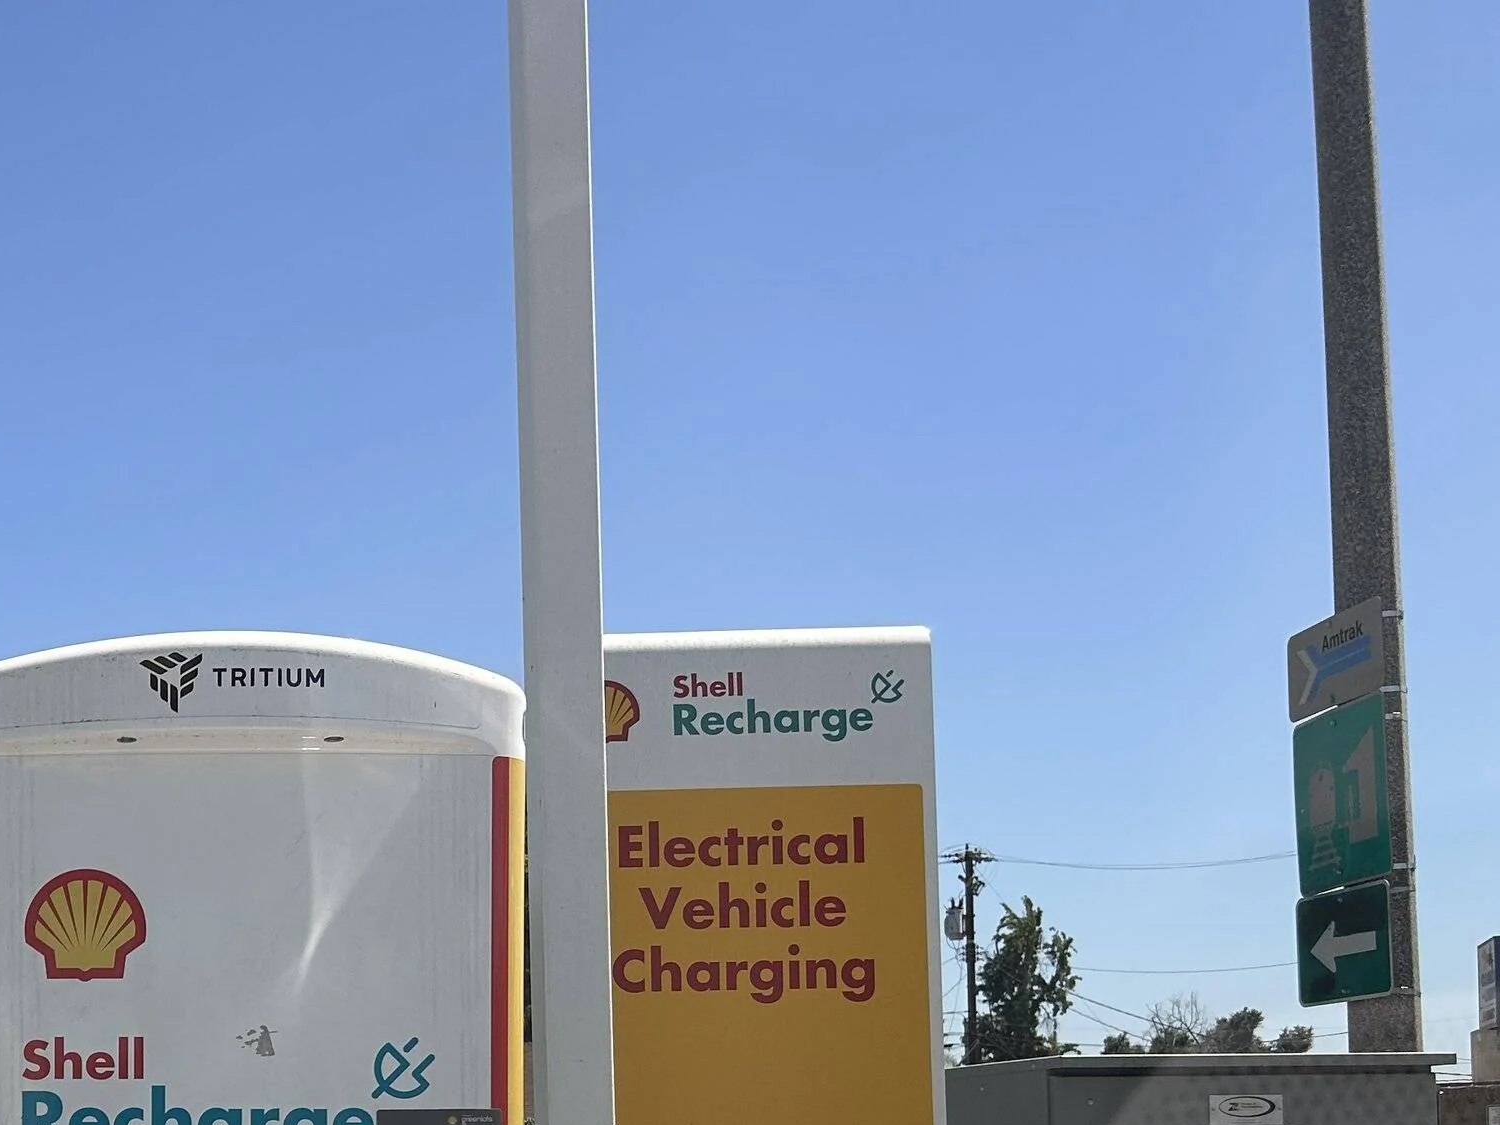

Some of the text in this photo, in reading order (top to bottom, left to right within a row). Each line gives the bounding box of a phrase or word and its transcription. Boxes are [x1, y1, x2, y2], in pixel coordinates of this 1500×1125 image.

[1322, 620, 1363, 652] Amtrak
[212, 666, 325, 688] TRITIUM
[673, 671, 743, 698] Shell
[673, 698, 873, 742] Recharge
[617, 816, 865, 868] Electrical
[638, 880, 847, 930] Vehicle
[612, 944, 875, 1004] Charging
[22, 1036, 144, 1081] Shell
